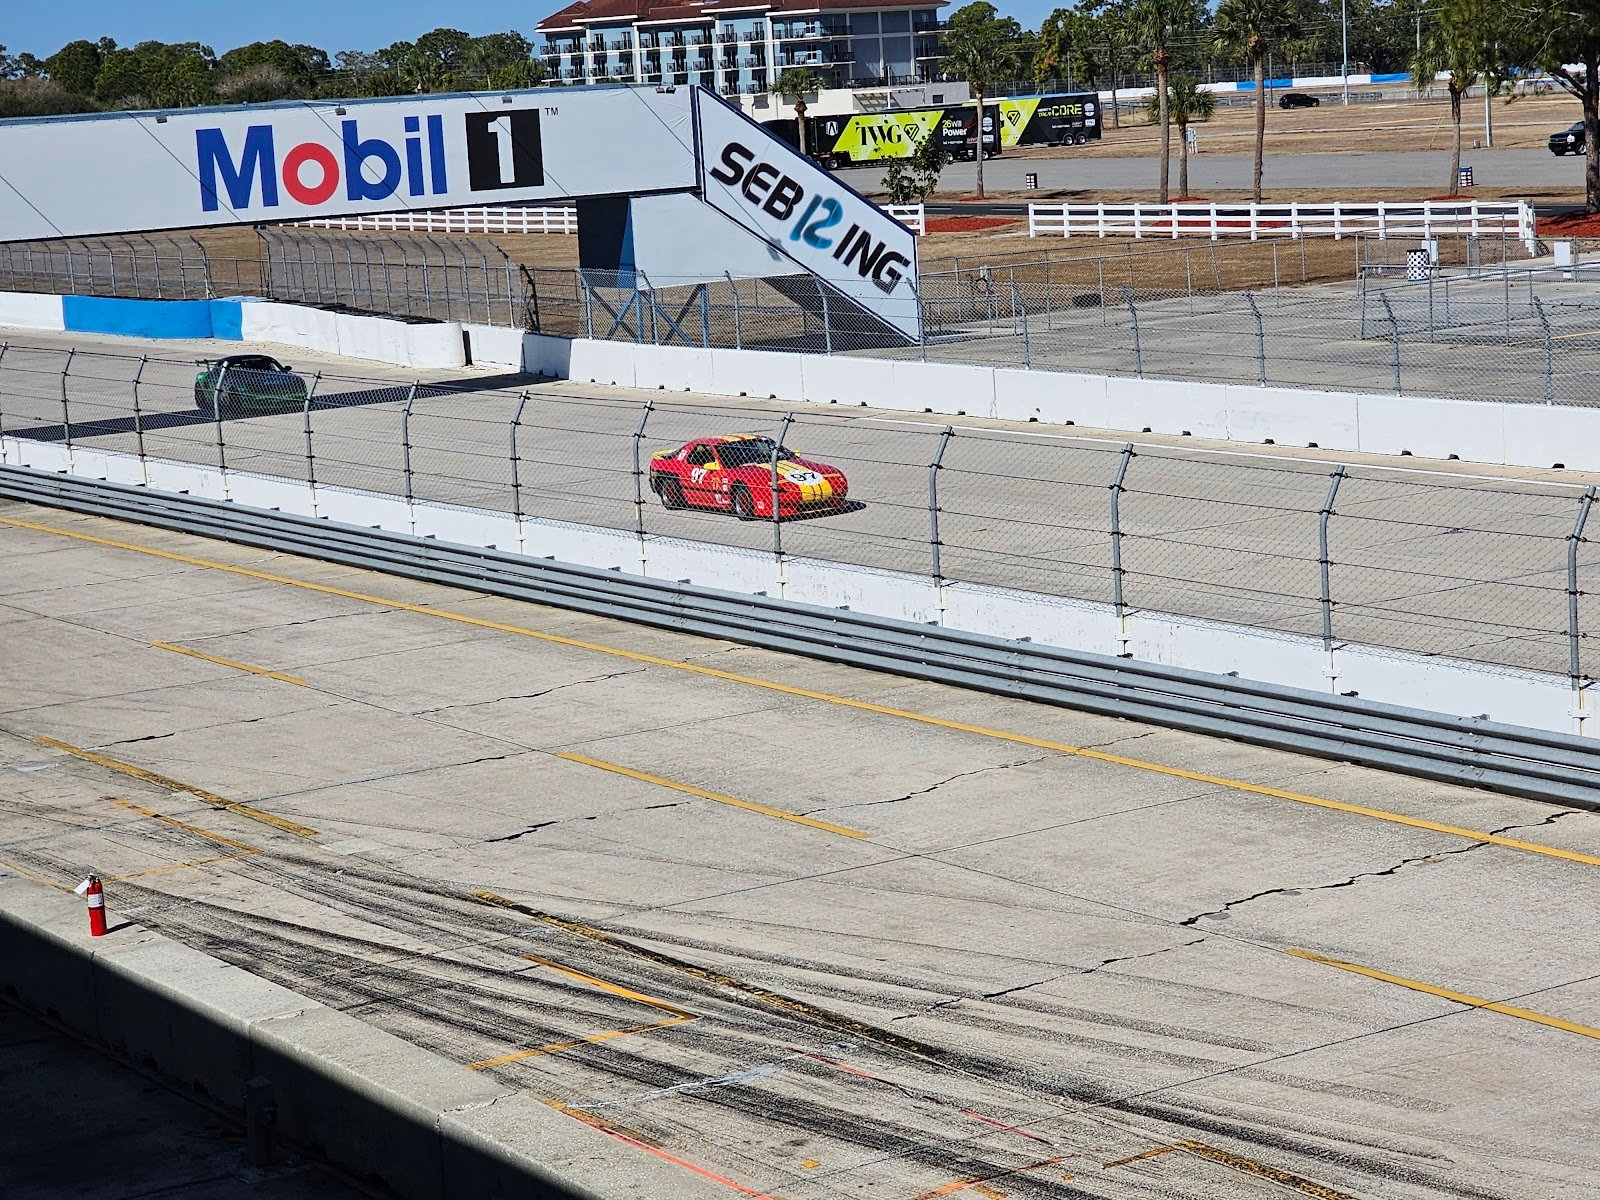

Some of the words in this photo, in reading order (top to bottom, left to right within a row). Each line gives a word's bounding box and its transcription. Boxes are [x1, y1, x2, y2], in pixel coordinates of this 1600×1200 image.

[1051, 104, 1082, 116] CORE
[856, 125, 902, 145] TWG
[196, 114, 448, 212] Mobil
[488, 115, 516, 184] 1
[691, 468, 707, 484] 97
[790, 472, 816, 482] 97
